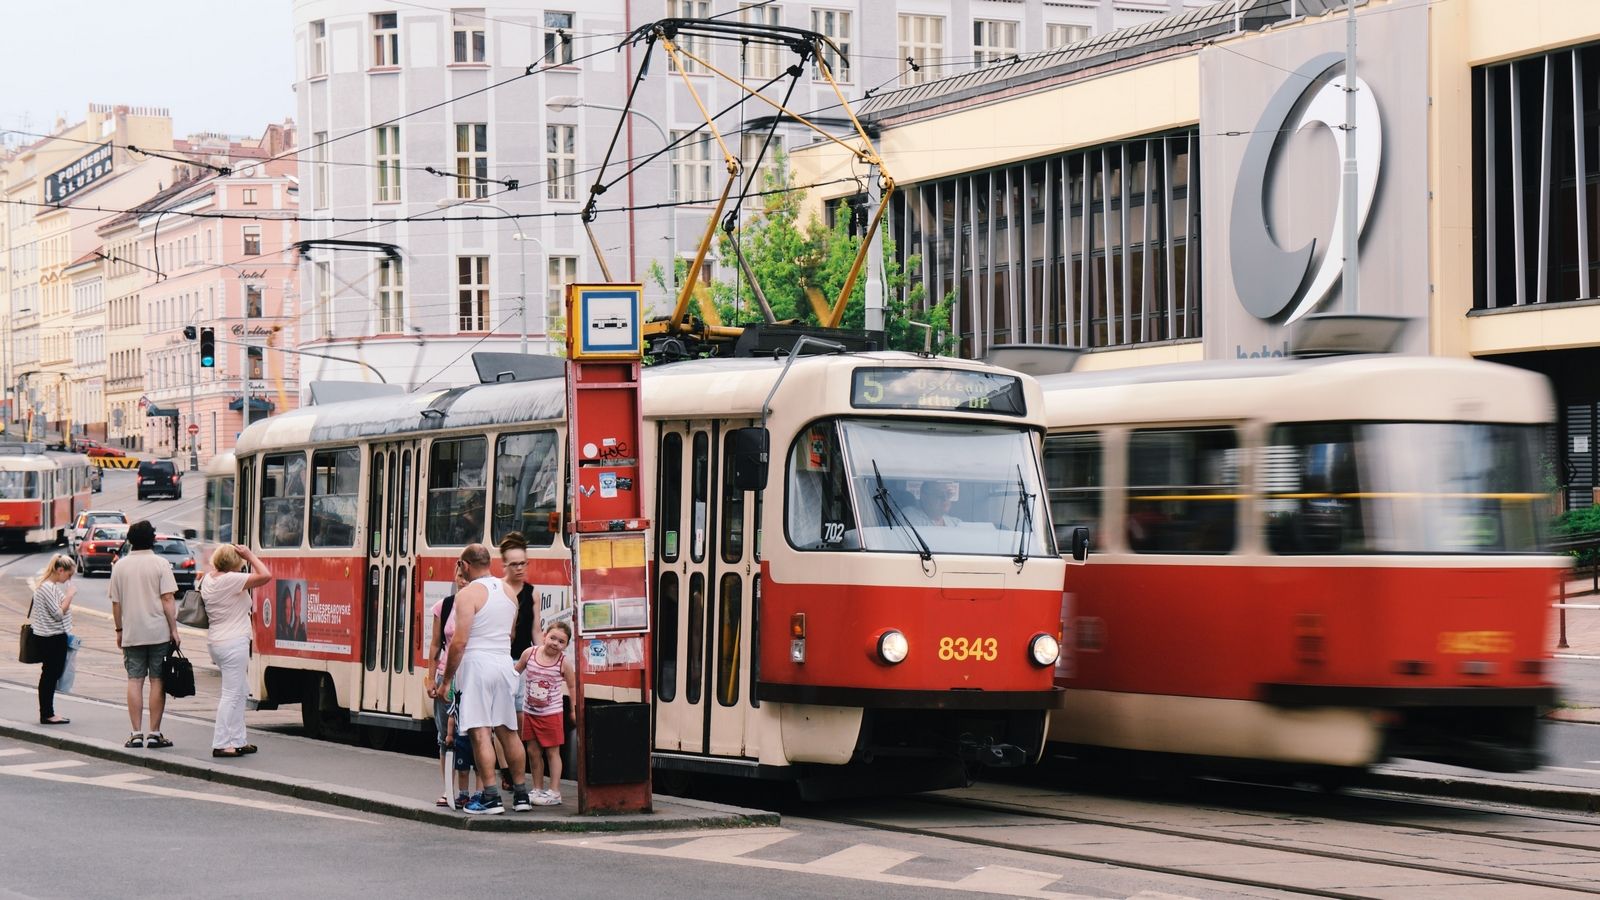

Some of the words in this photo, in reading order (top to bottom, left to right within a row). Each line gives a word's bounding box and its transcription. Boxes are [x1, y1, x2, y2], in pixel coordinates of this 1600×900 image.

[863, 372, 884, 404] 5
[824, 522, 845, 541] 702
[331, 614, 342, 625] 2014
[938, 637, 998, 661] 8343
